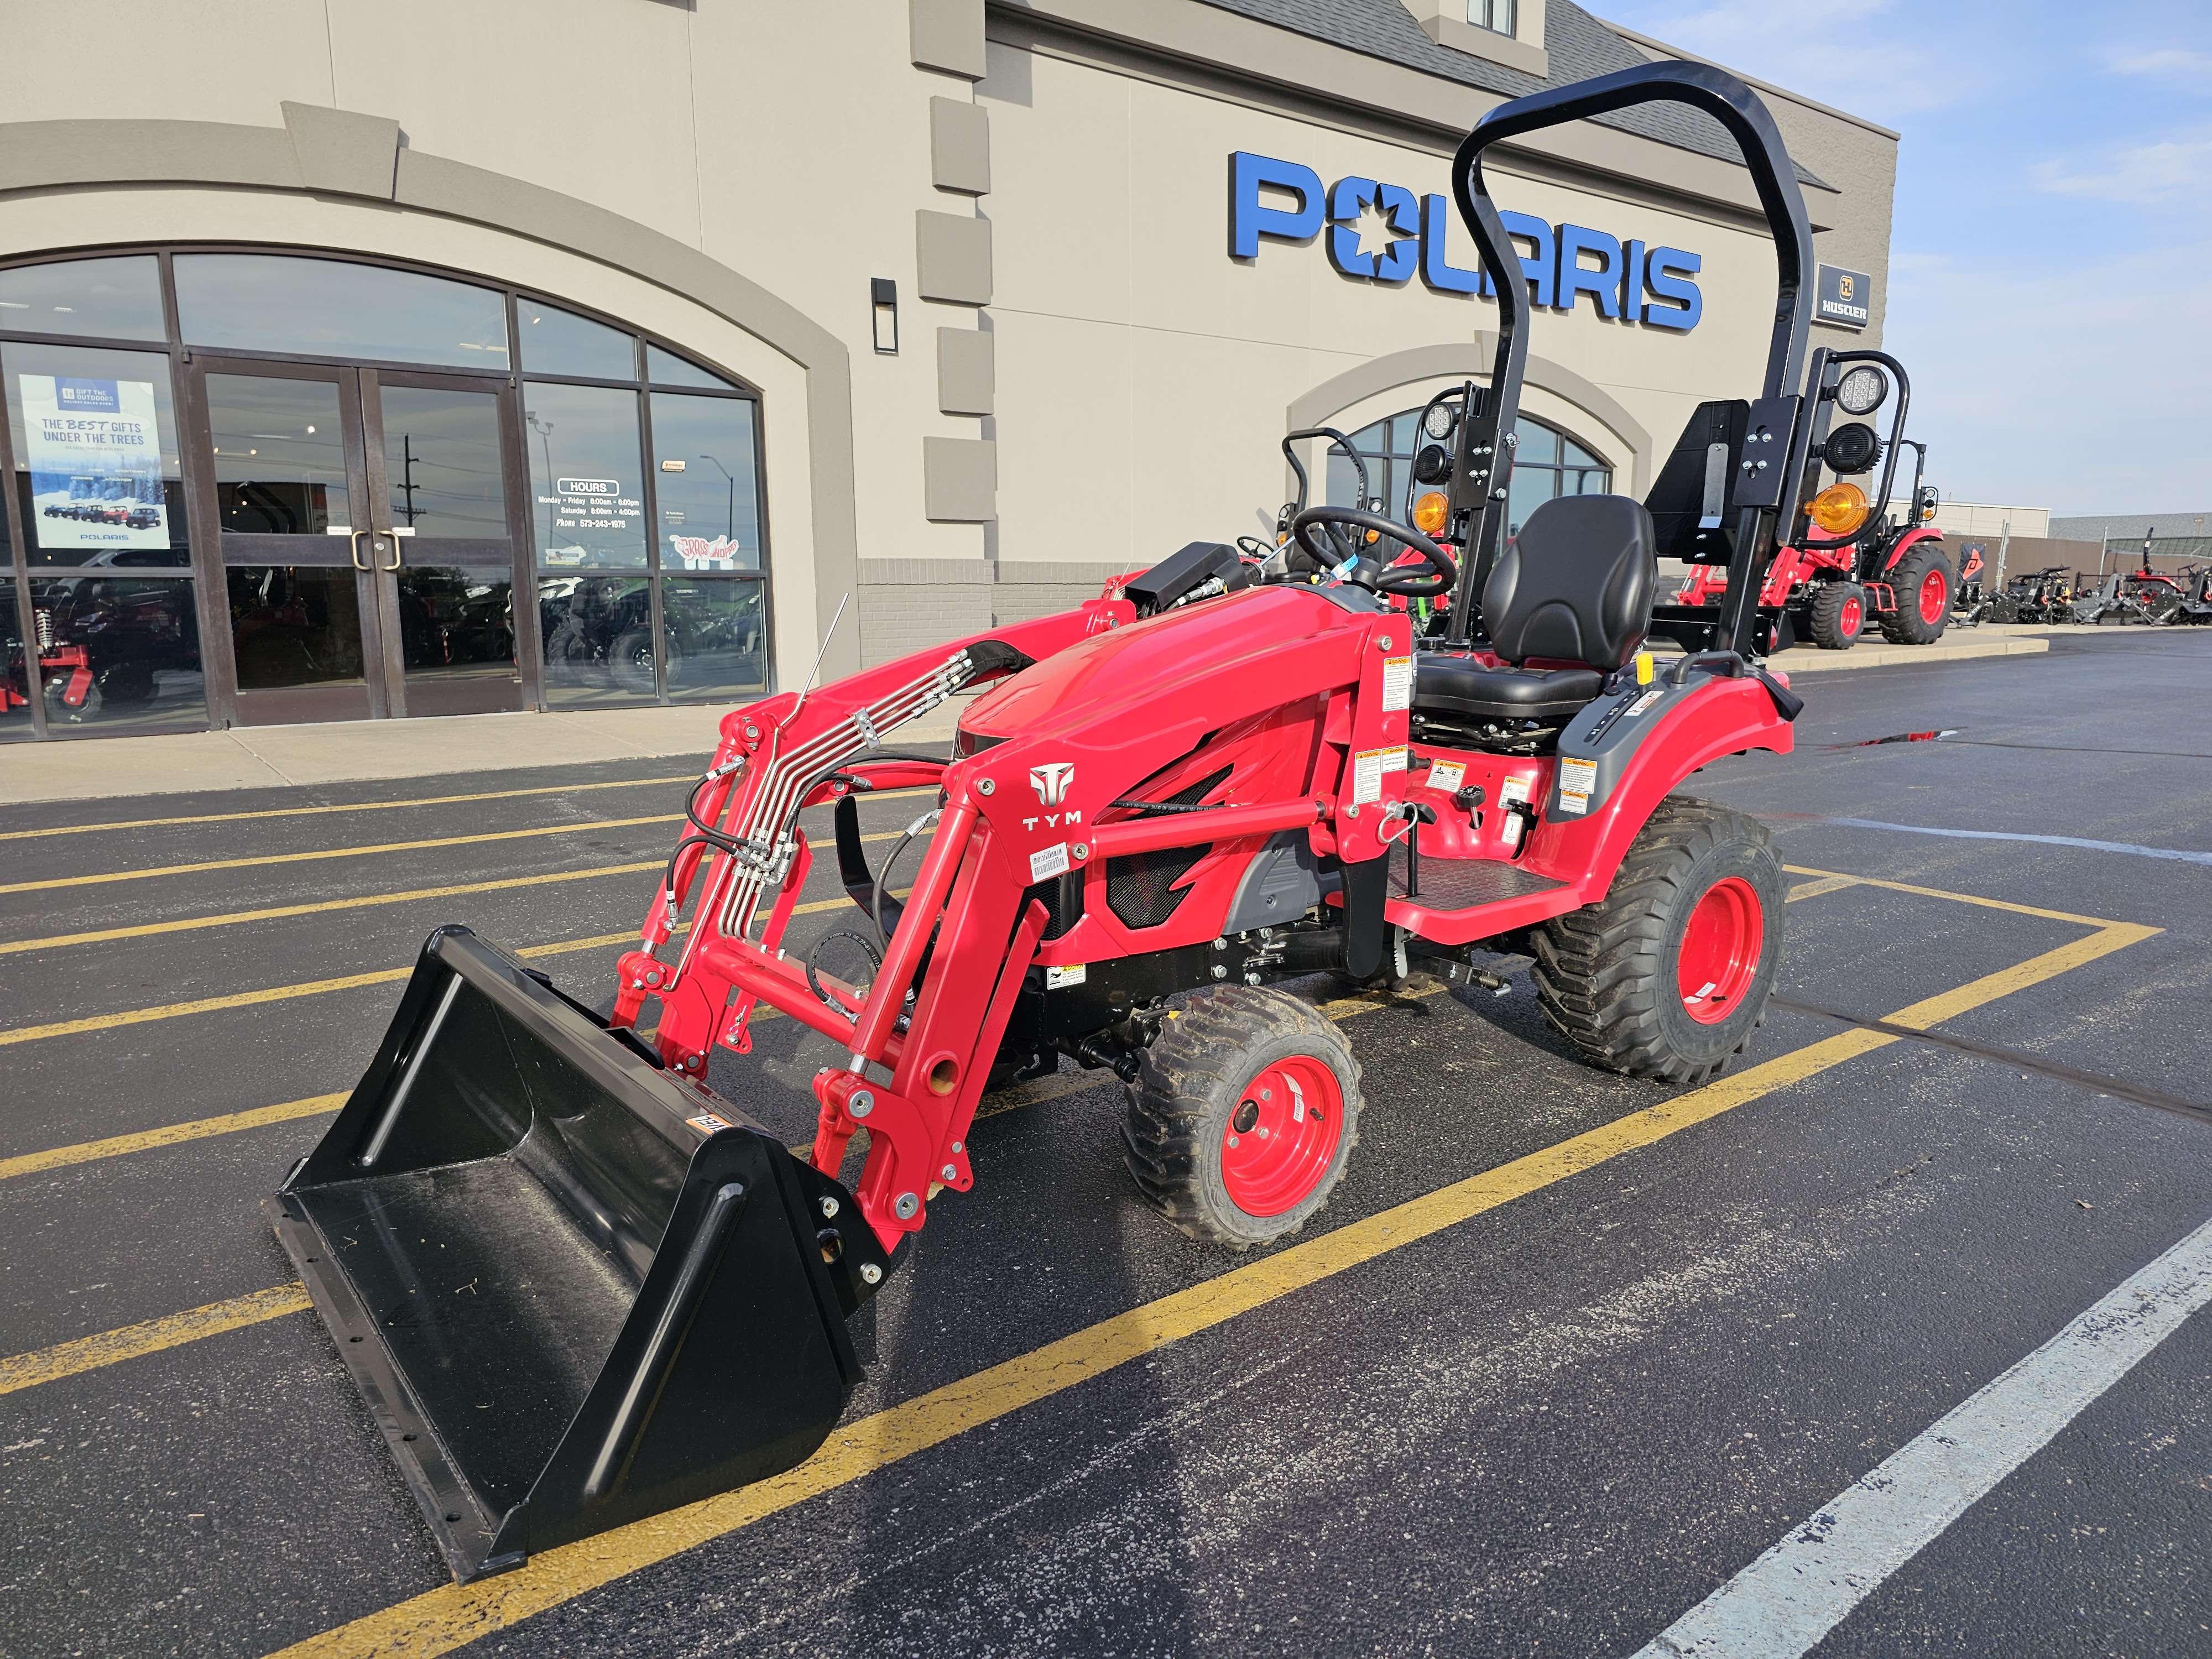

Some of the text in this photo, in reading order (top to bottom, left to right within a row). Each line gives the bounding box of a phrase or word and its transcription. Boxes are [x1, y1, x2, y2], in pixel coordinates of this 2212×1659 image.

[1823, 300, 1867, 320] HUSTLER
[42, 419, 142, 433] THE BEST GIFTS
[44, 431, 144, 445] UNDER THE TREES
[570, 482, 607, 493] HOURS
[538, 496, 561, 505] Monday
[568, 497, 586, 505] Friday
[618, 498, 640, 507] 6:00pm
[561, 507, 586, 515] Saturday
[618, 508, 640, 517] 4:00pm
[556, 518, 626, 528] Phone 573-243-1975
[1023, 811, 1081, 831] TYM
